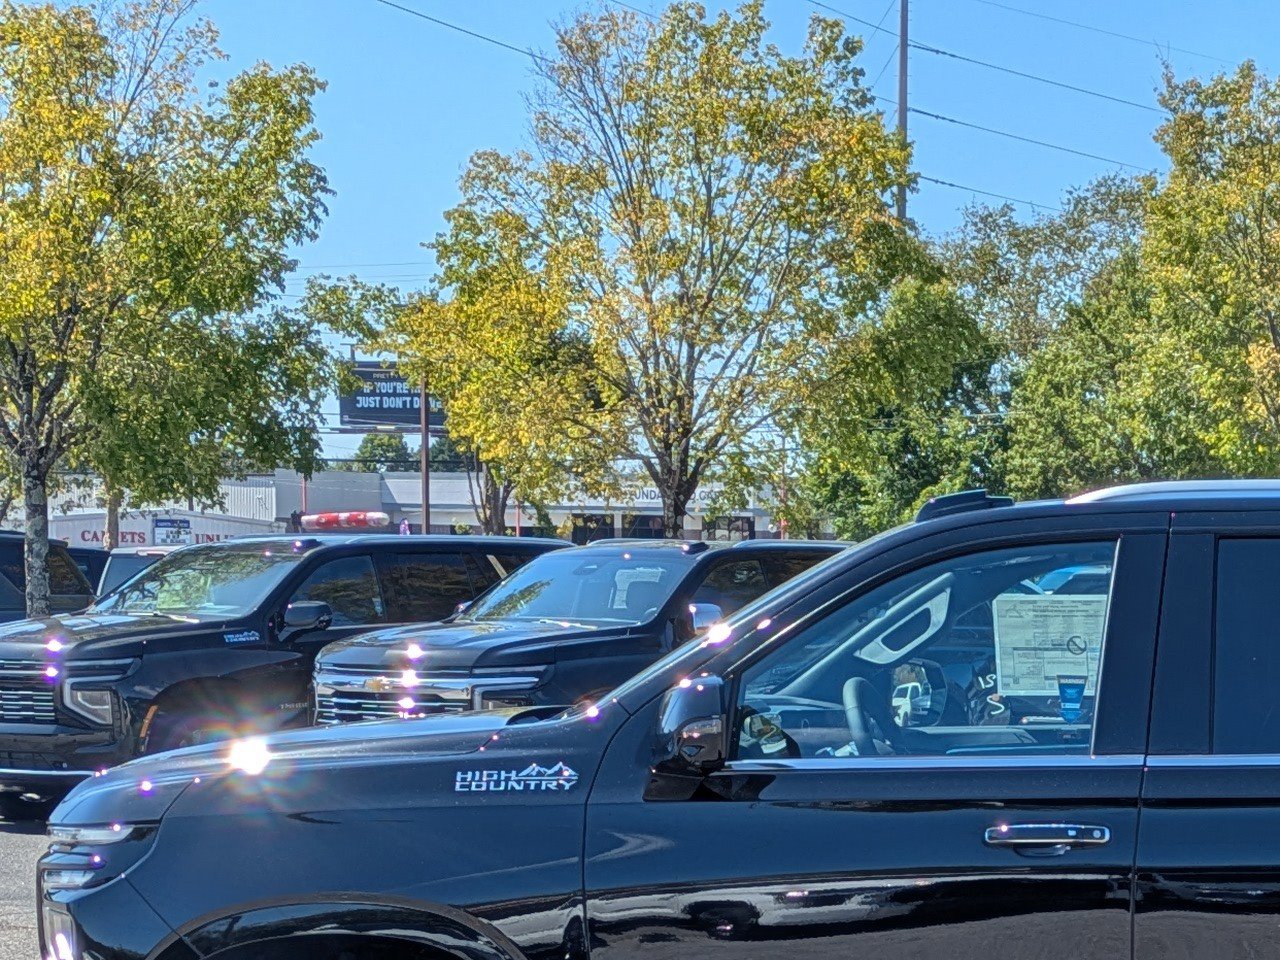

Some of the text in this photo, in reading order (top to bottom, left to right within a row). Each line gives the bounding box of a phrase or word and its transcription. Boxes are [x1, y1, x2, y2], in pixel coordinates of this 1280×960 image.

[375, 381, 409, 394] YOU'RE
[356, 396, 443, 409] JUST DON'T DVE
[80, 530, 146, 544] CAETS
[456, 770, 516, 781] HIGH
[455, 780, 578, 792] COUNTRY
